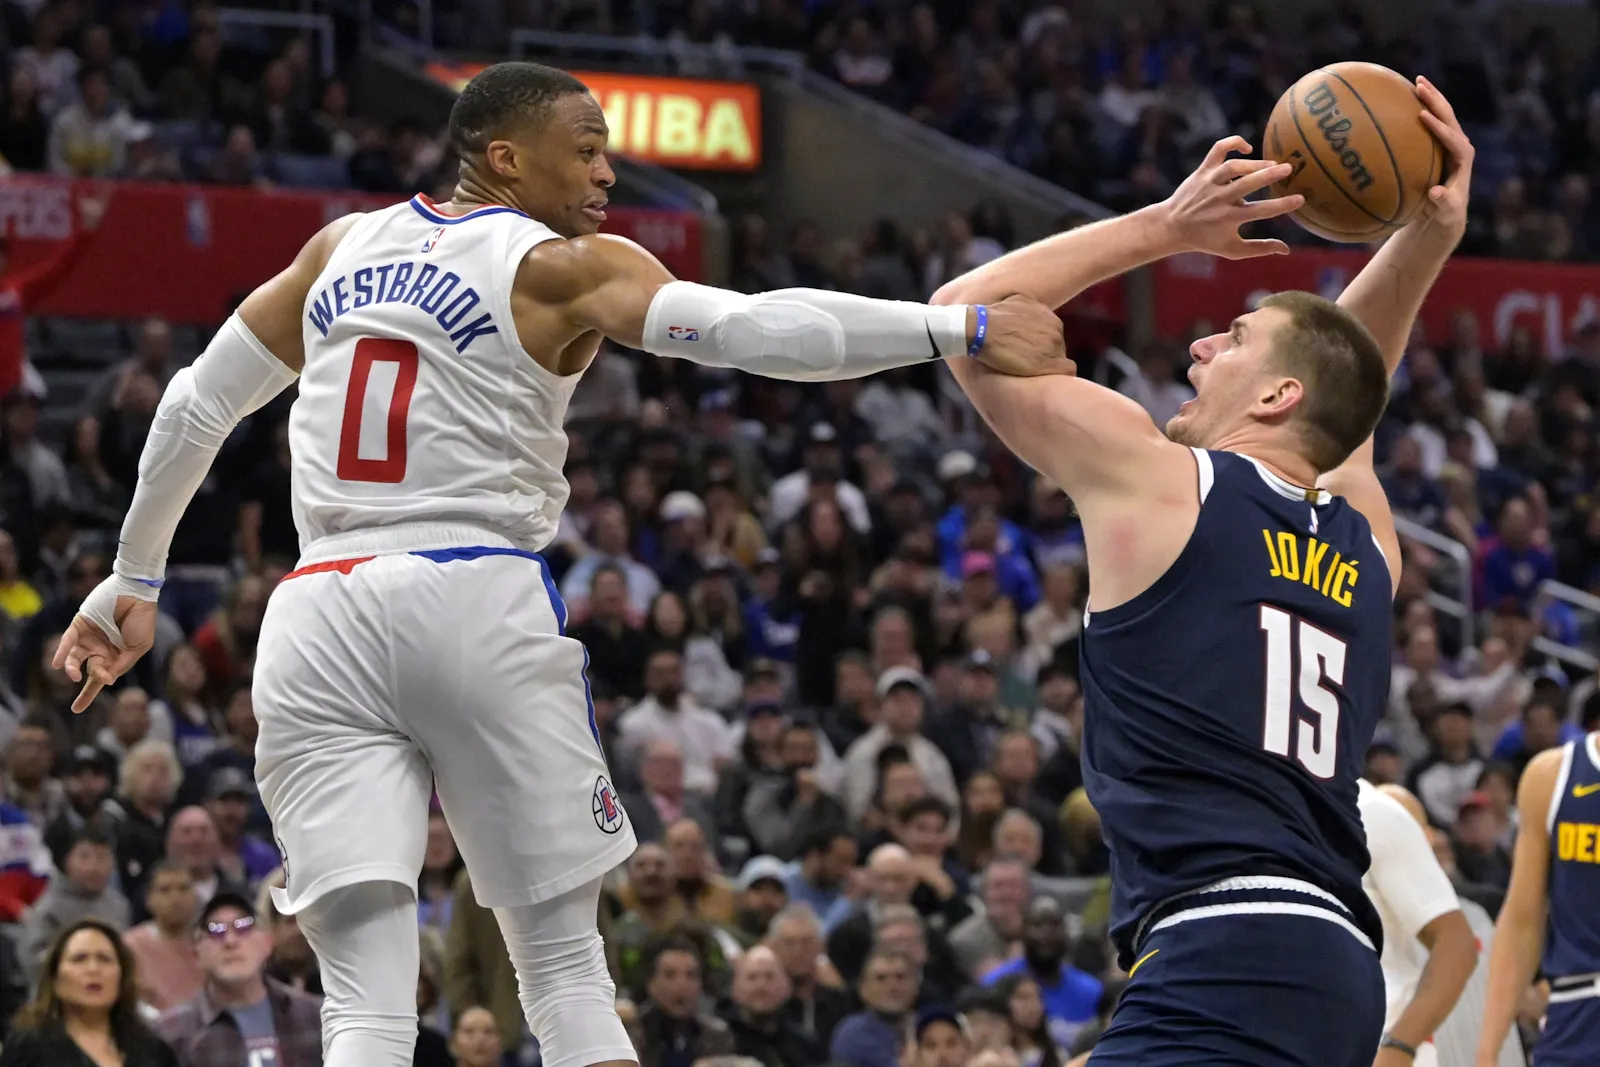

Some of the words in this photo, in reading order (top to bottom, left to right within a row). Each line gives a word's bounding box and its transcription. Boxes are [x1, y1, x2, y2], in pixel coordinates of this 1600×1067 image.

[1303, 82, 1375, 191] Wilson
[309, 261, 499, 355] WESTBROOK
[336, 337, 419, 484] 0
[1262, 528, 1360, 608] JOKIĆ
[1259, 603, 1348, 779] 15
[1557, 822, 1600, 864] DE
